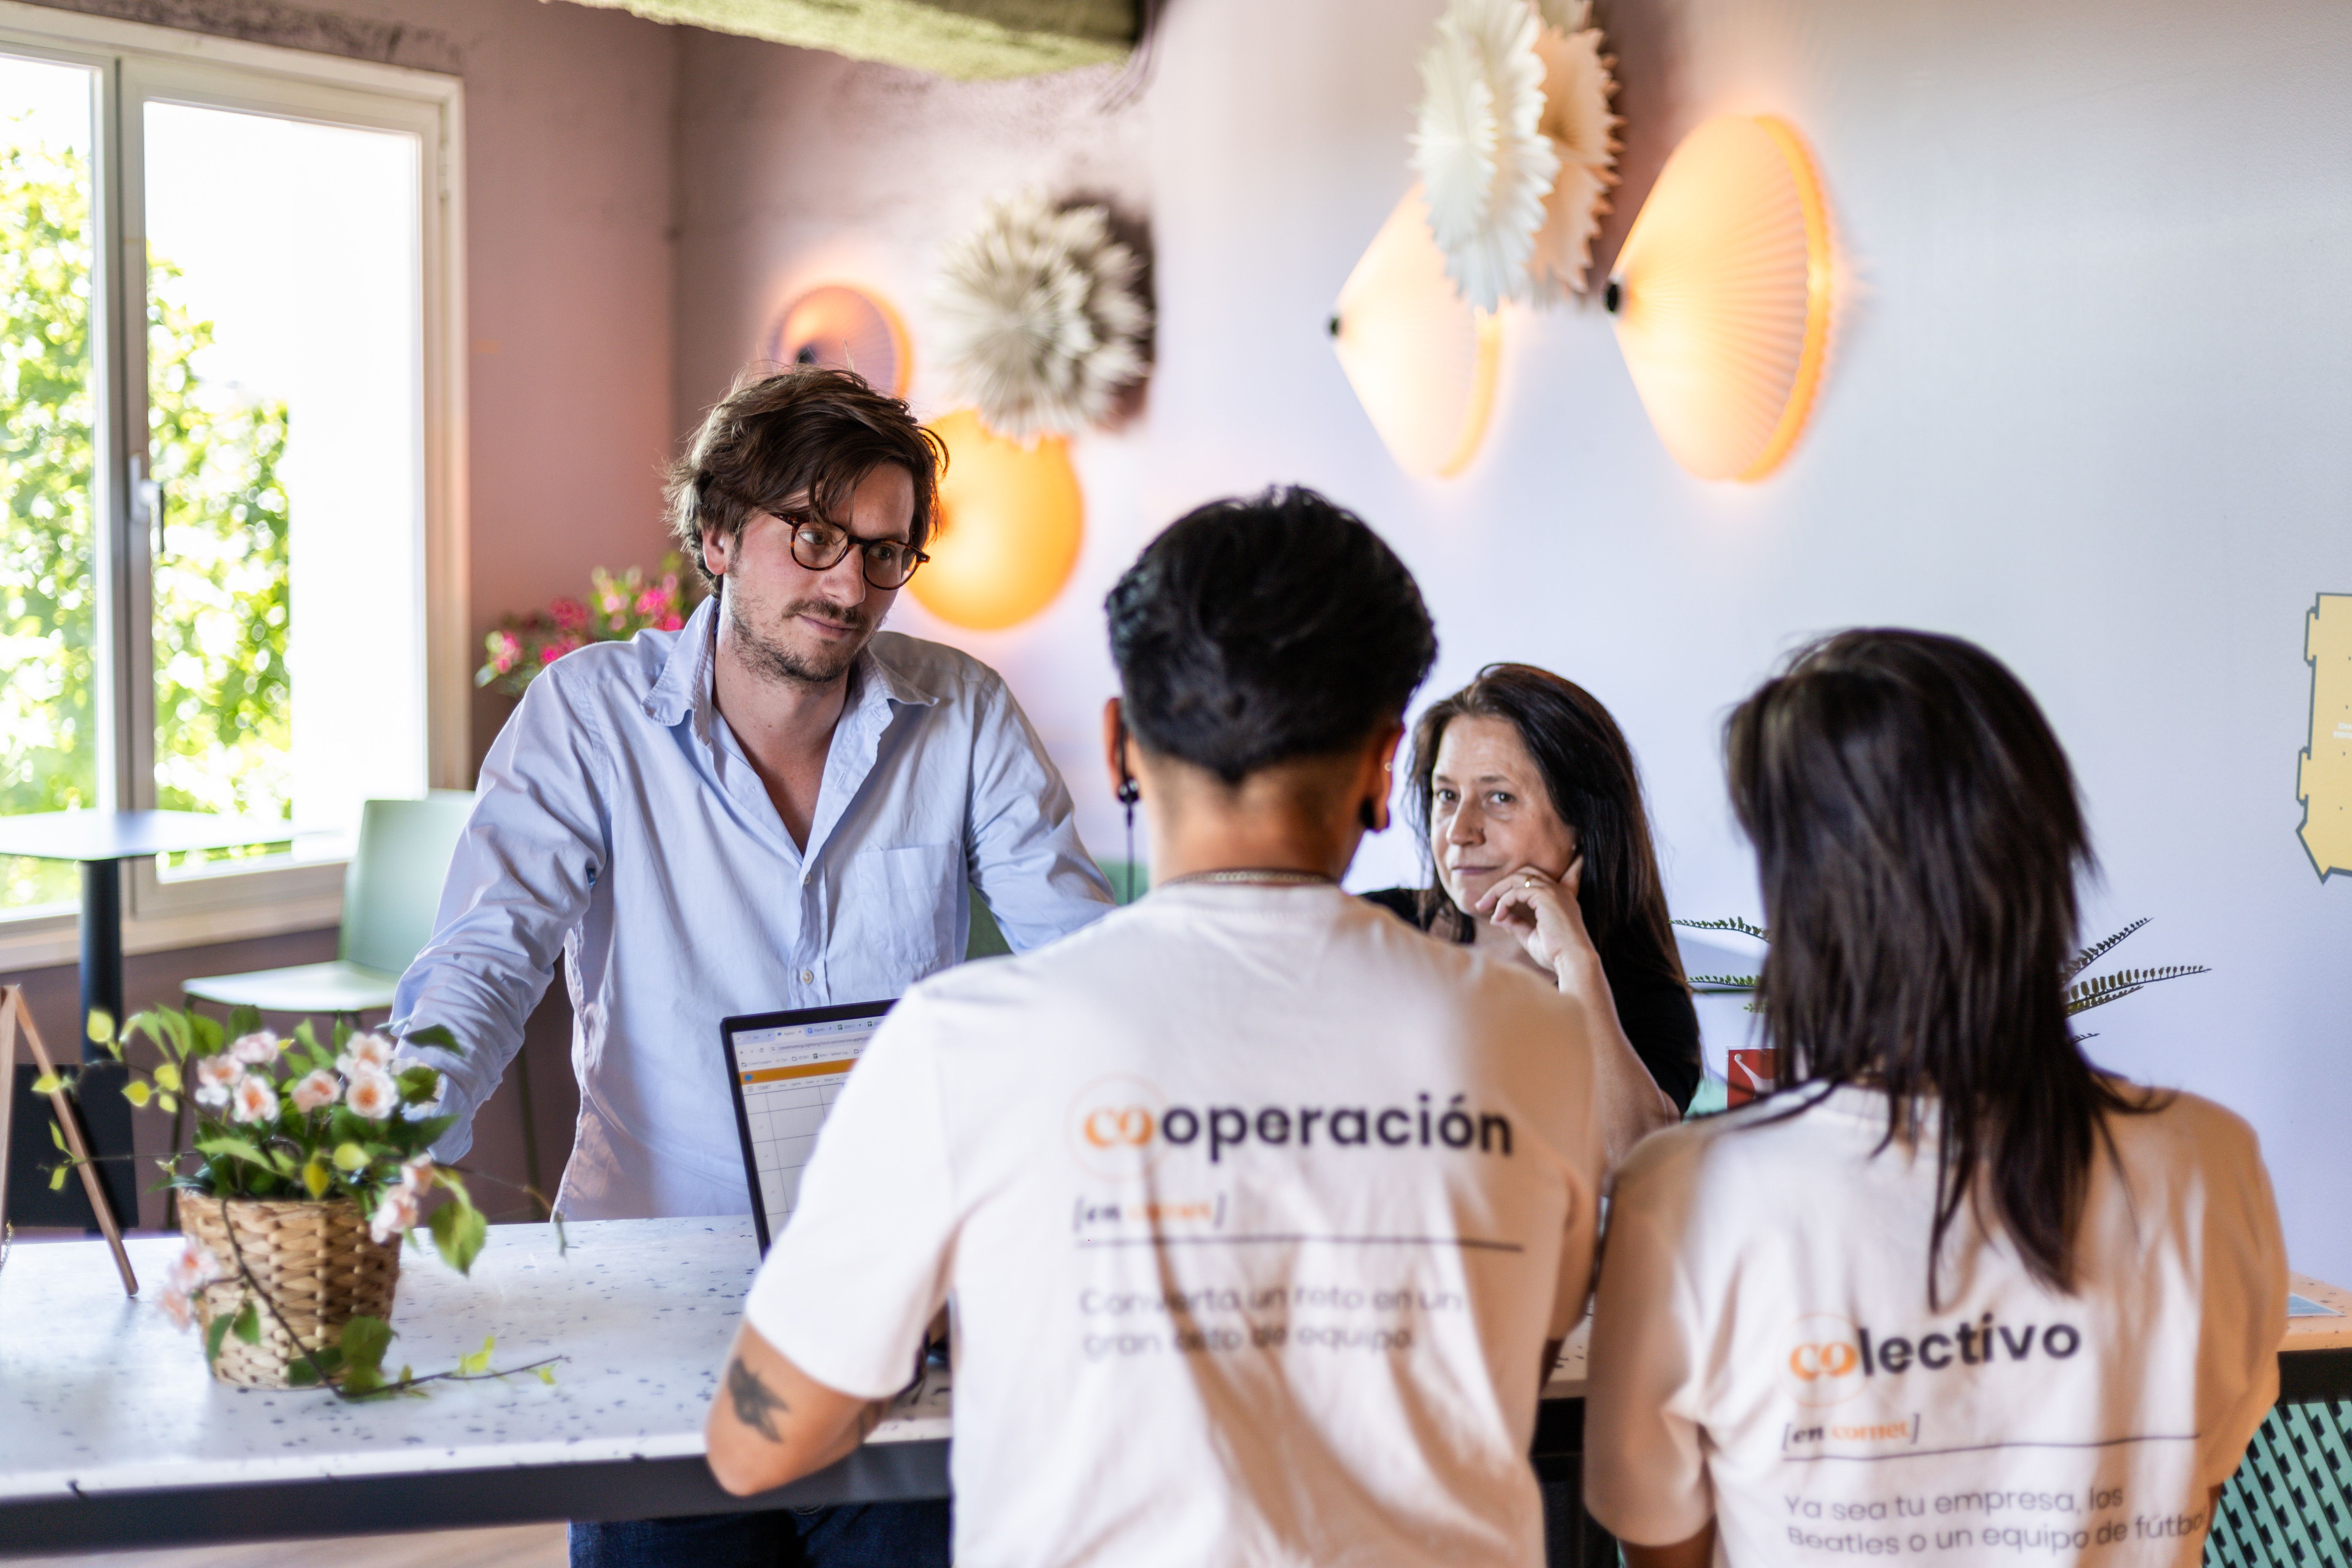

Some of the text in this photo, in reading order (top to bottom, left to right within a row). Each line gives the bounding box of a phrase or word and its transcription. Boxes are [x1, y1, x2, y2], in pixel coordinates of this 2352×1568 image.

[1085, 1093, 1512, 1163] cooperación
[1790, 1311, 2081, 1379] colectivo
[1784, 1485, 2123, 1522] Ya sea tu empresa, los
[1787, 1511, 2205, 1556] Beatles o un equipo de fútbo
